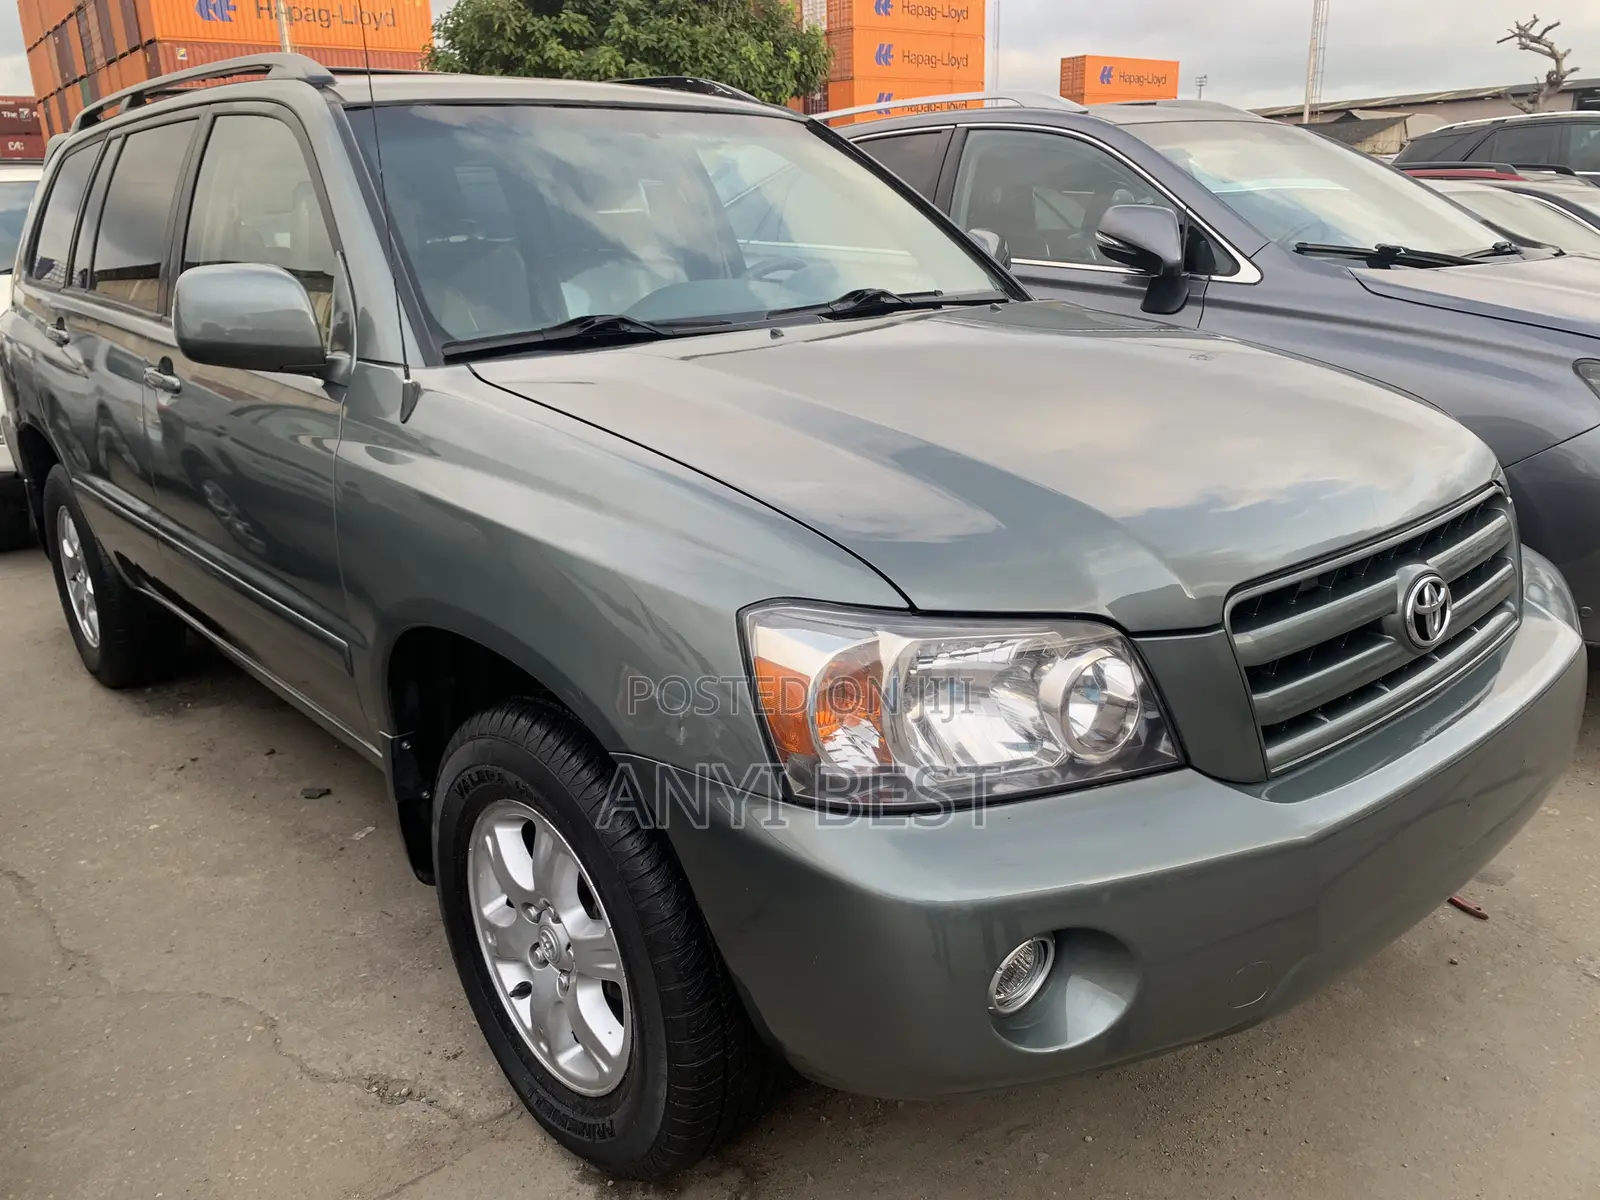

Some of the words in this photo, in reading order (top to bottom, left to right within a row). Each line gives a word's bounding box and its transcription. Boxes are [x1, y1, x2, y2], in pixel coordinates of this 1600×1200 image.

[255, 0, 397, 31] Hapag-Lloyd
[901, 0, 969, 22] Hapag-Lloyd
[902, 49, 969, 69] Hapag-Lloyd
[1118, 71, 1167, 87] Hapag-Lloyd
